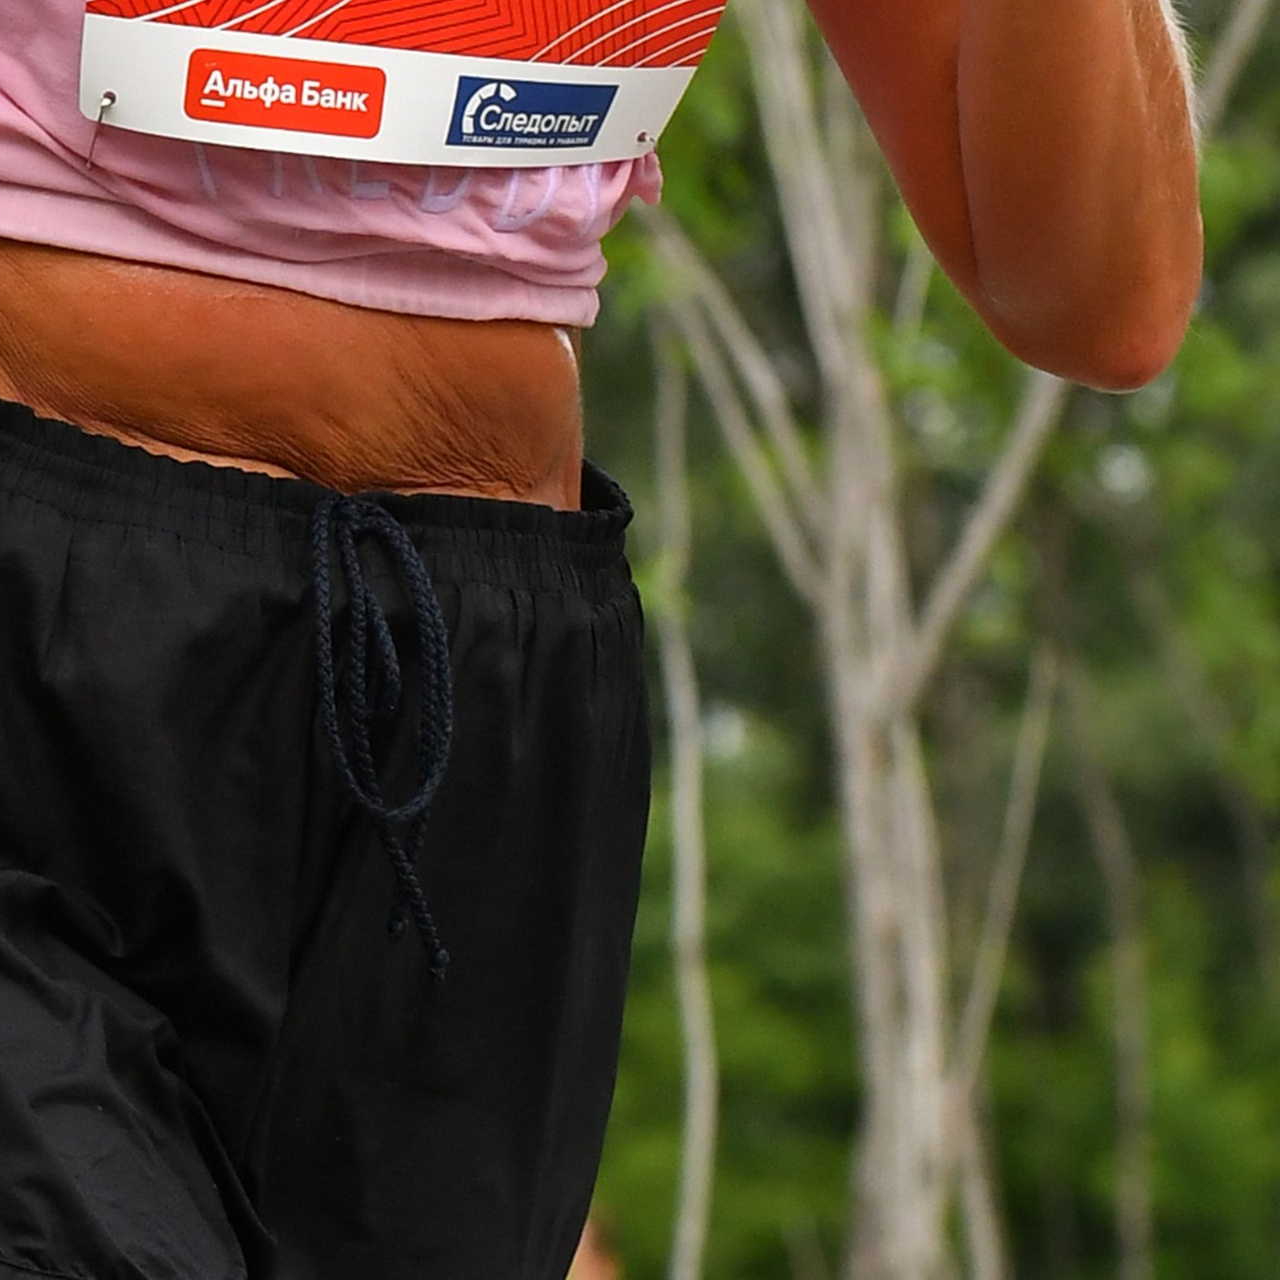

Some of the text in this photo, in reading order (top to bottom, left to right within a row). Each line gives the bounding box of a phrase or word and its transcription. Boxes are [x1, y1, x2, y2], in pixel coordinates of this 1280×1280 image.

[201, 70, 369, 111] Альфа Банк
[480, 104, 599, 134] Следопыт
